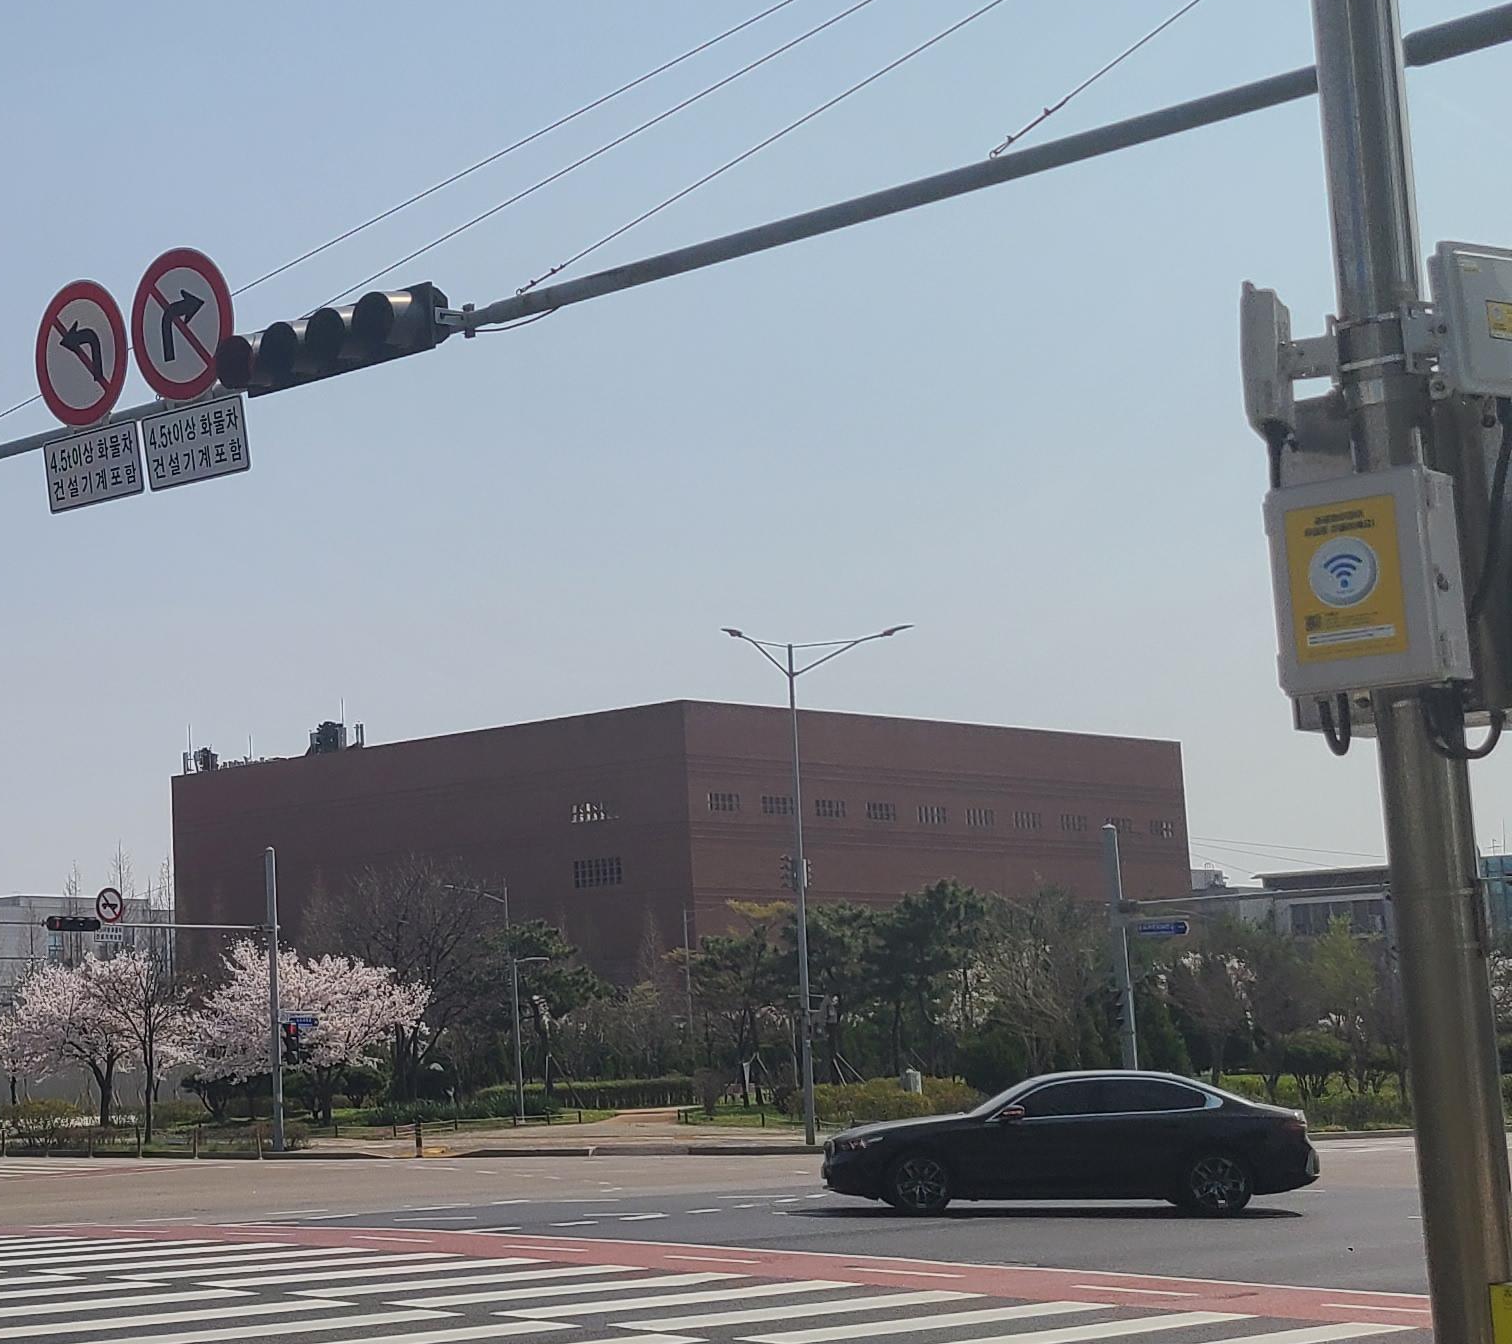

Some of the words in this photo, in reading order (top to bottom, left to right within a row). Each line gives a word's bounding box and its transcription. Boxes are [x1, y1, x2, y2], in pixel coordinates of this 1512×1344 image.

[149, 416, 196, 450] 4.5t이상
[199, 405, 238, 436] 화물차
[50, 441, 93, 474] 4.5t이상
[97, 430, 133, 460] 화물차
[152, 437, 242, 479] 건설기계포함
[53, 461, 137, 501] 건설기계포함
